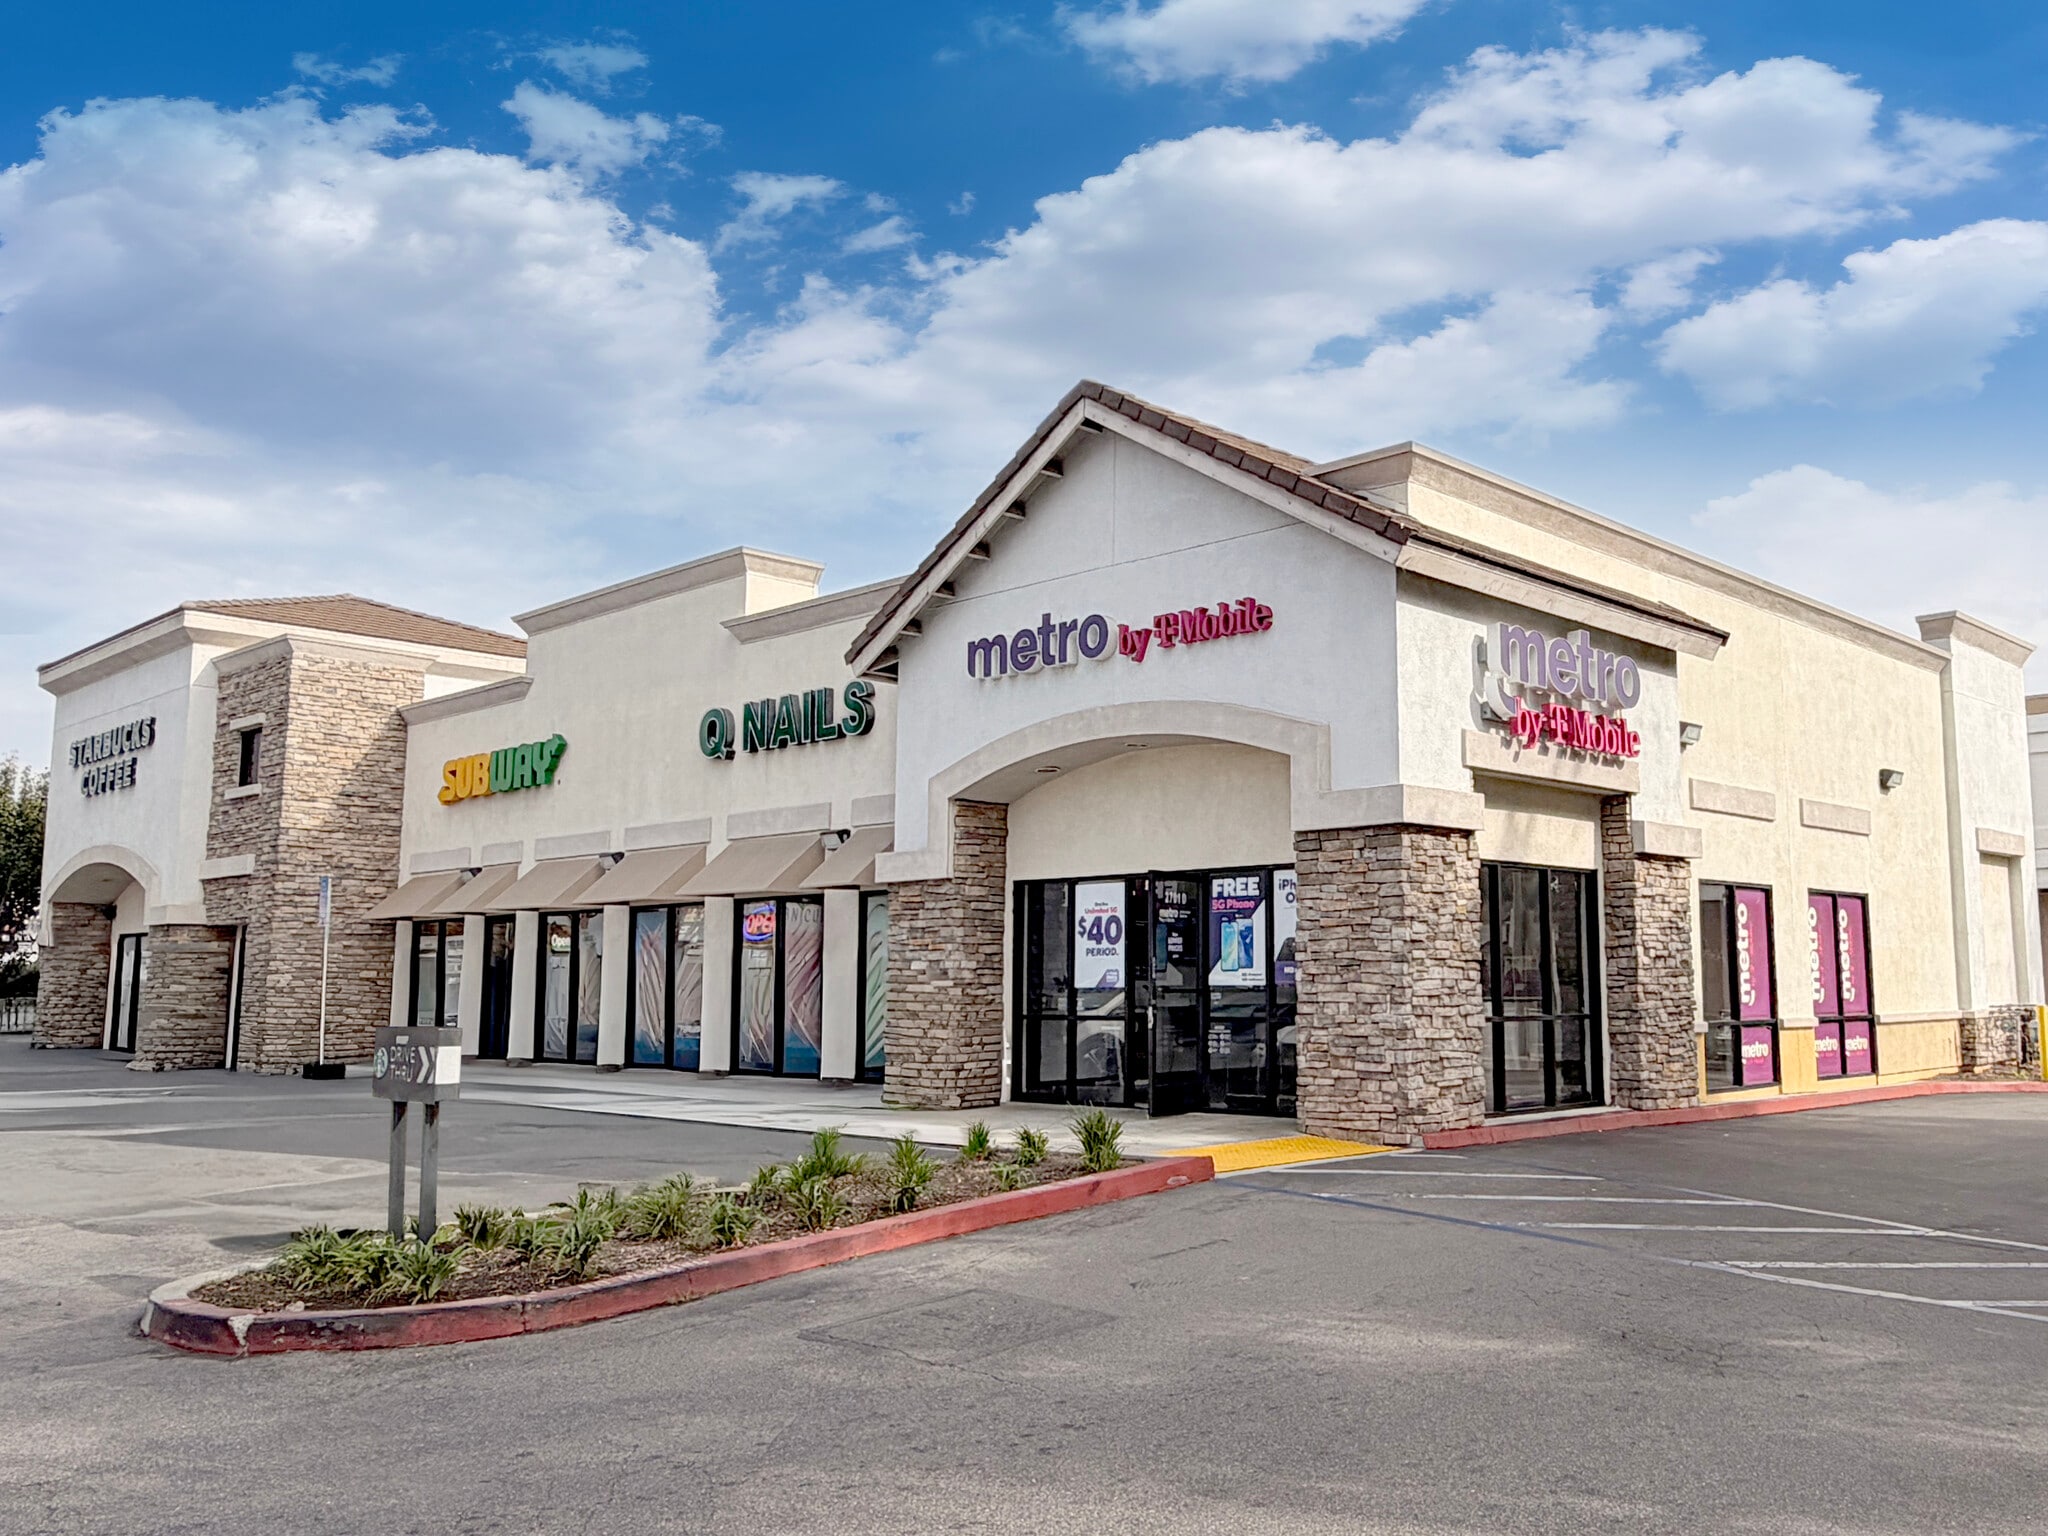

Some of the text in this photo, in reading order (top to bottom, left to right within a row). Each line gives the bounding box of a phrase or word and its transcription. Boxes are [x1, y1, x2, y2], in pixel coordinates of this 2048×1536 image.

[967, 612, 1112, 679] metro
[1117, 623, 1152, 663] by
[1490, 622, 1641, 710] metro
[69, 716, 156, 768] STARBUCKS
[699, 680, 876, 760] Q NAILS
[1511, 696, 1544, 750] by
[81, 757, 137, 798] COFFEE
[438, 733, 567, 806] SUBWAY
[1212, 876, 1260, 898] FREE
[1278, 878, 1297, 891] iPh
[1077, 915, 1123, 945] $40
[1737, 902, 1753, 1004] metro
[1839, 908, 1854, 1001] metro
[390, 1046, 416, 1064] DRIVE
[1741, 1041, 1769, 1058] metro
